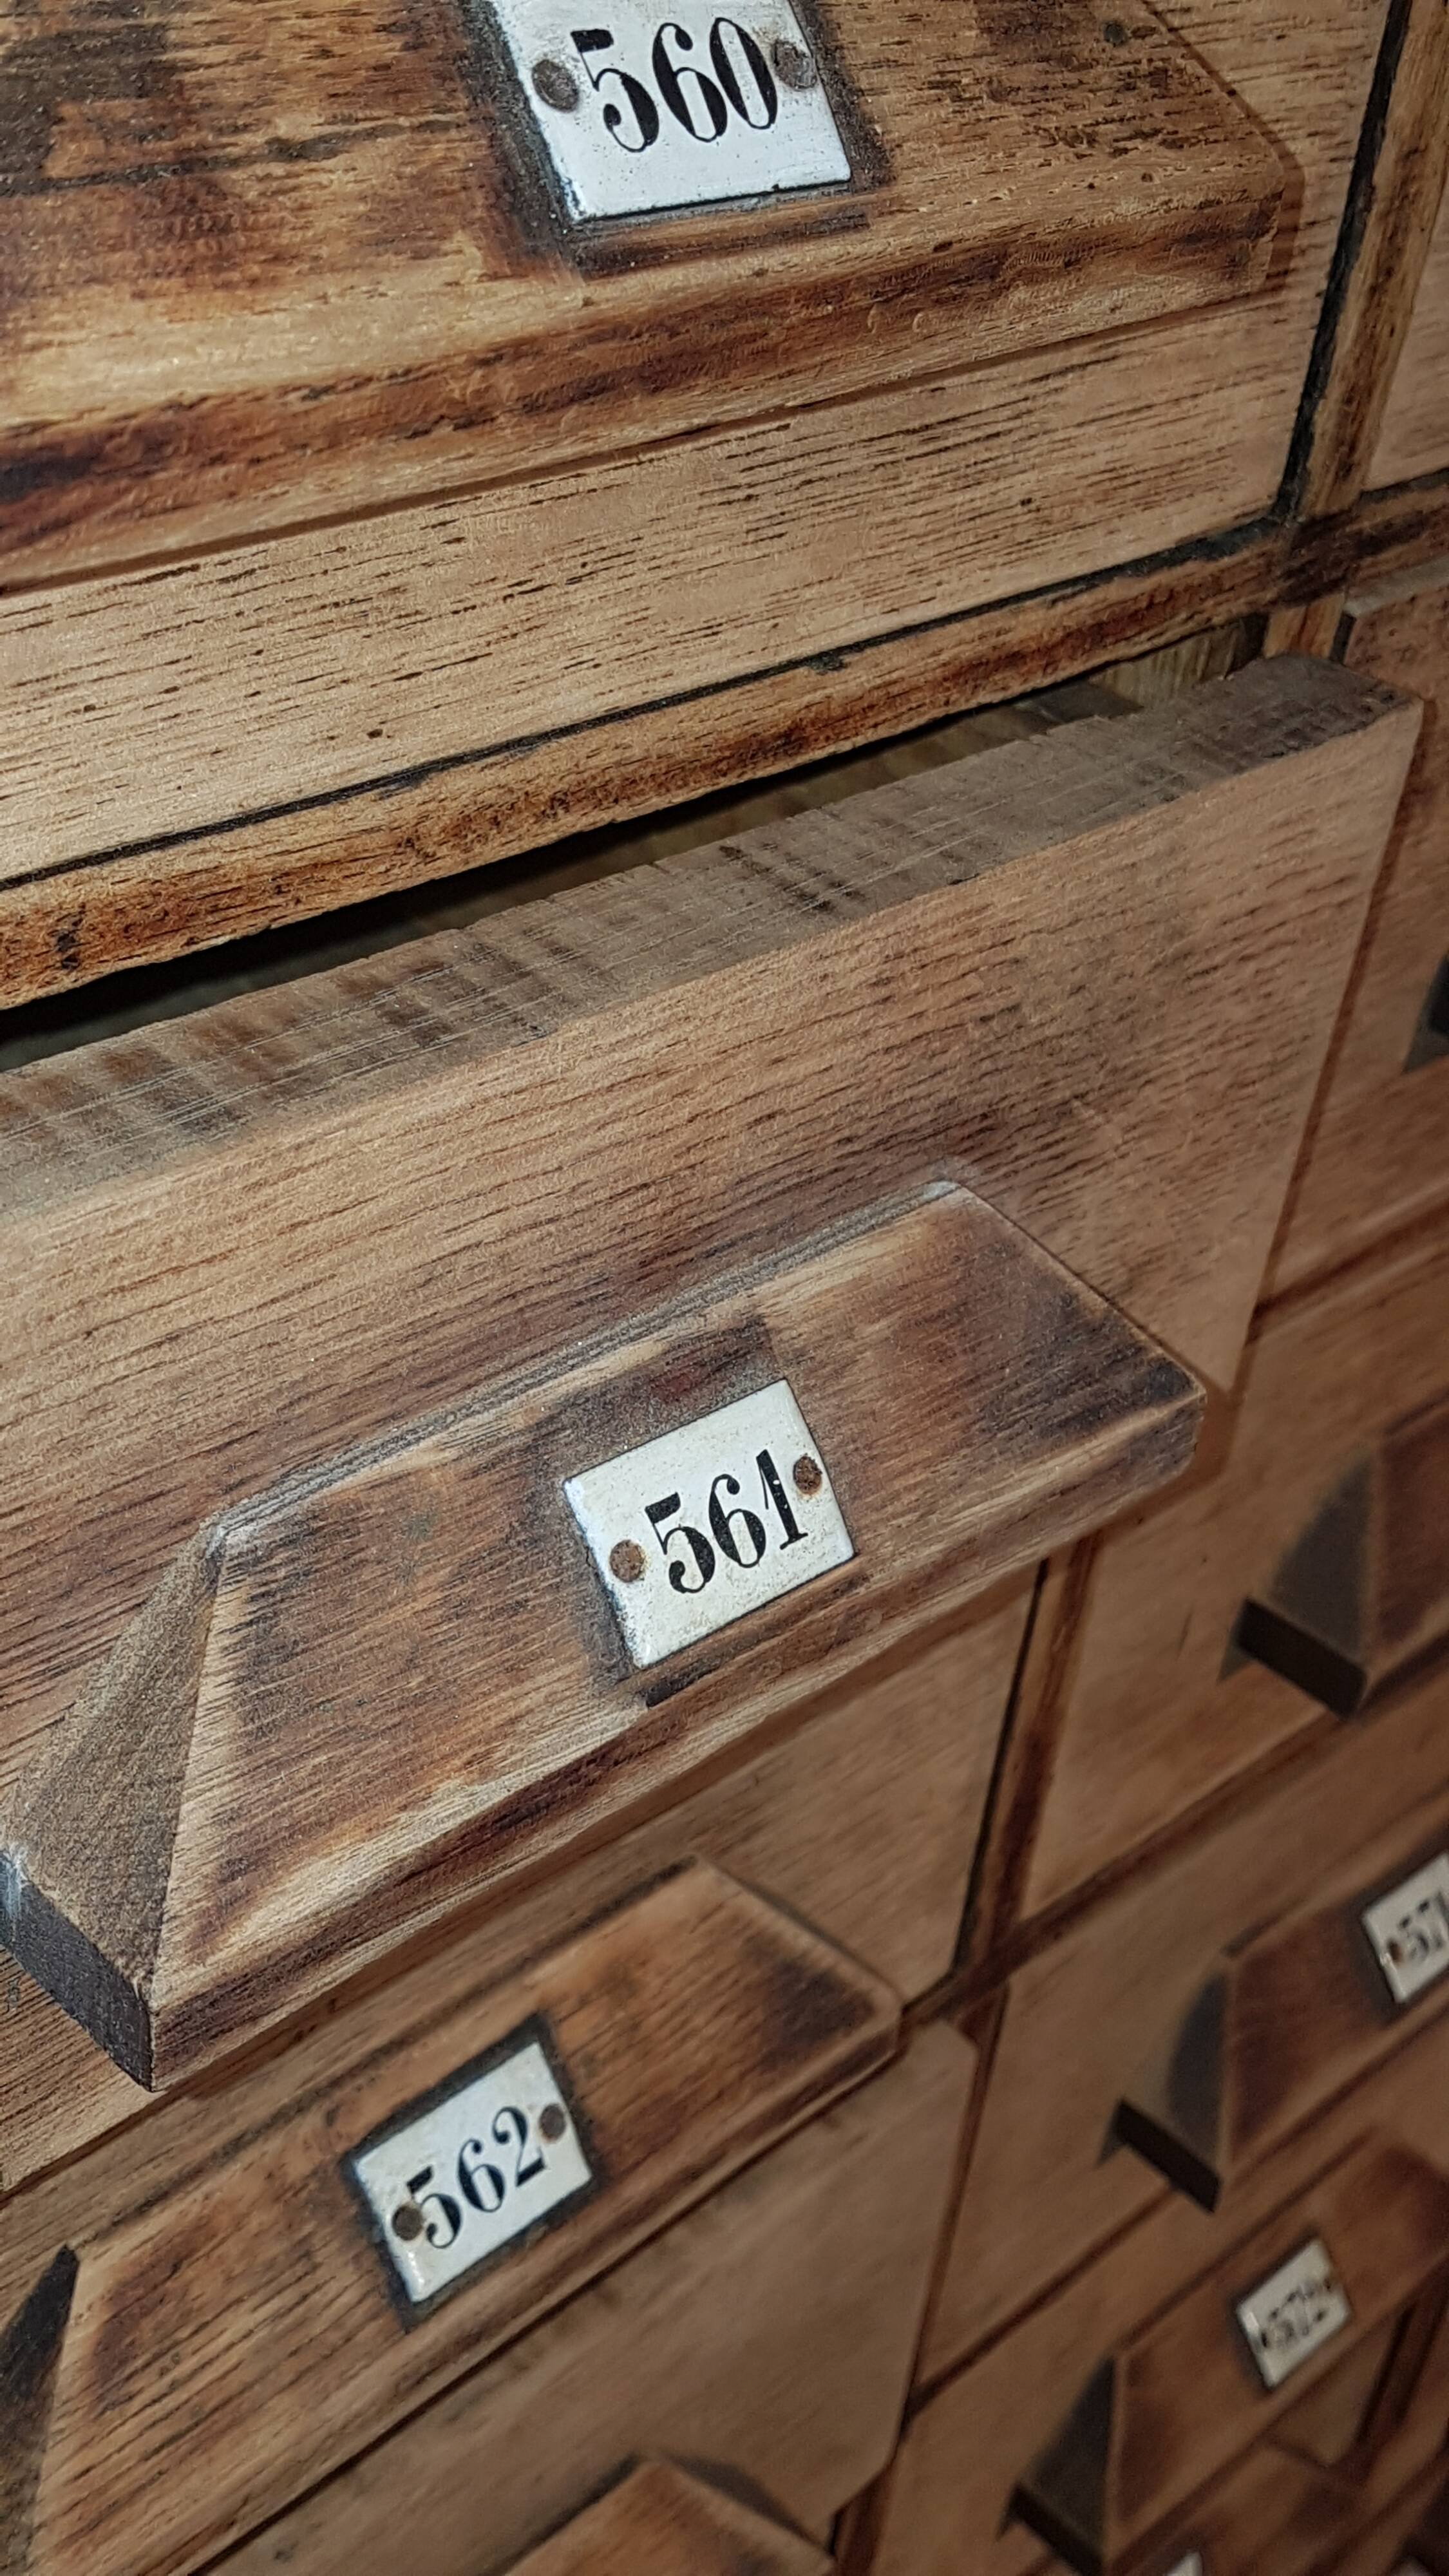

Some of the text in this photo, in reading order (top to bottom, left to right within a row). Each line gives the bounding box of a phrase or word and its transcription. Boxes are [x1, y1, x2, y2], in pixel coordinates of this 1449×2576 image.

[570, 17, 779, 153] 560
[645, 1448, 809, 1594] 561
[406, 2106, 546, 2249] 562
